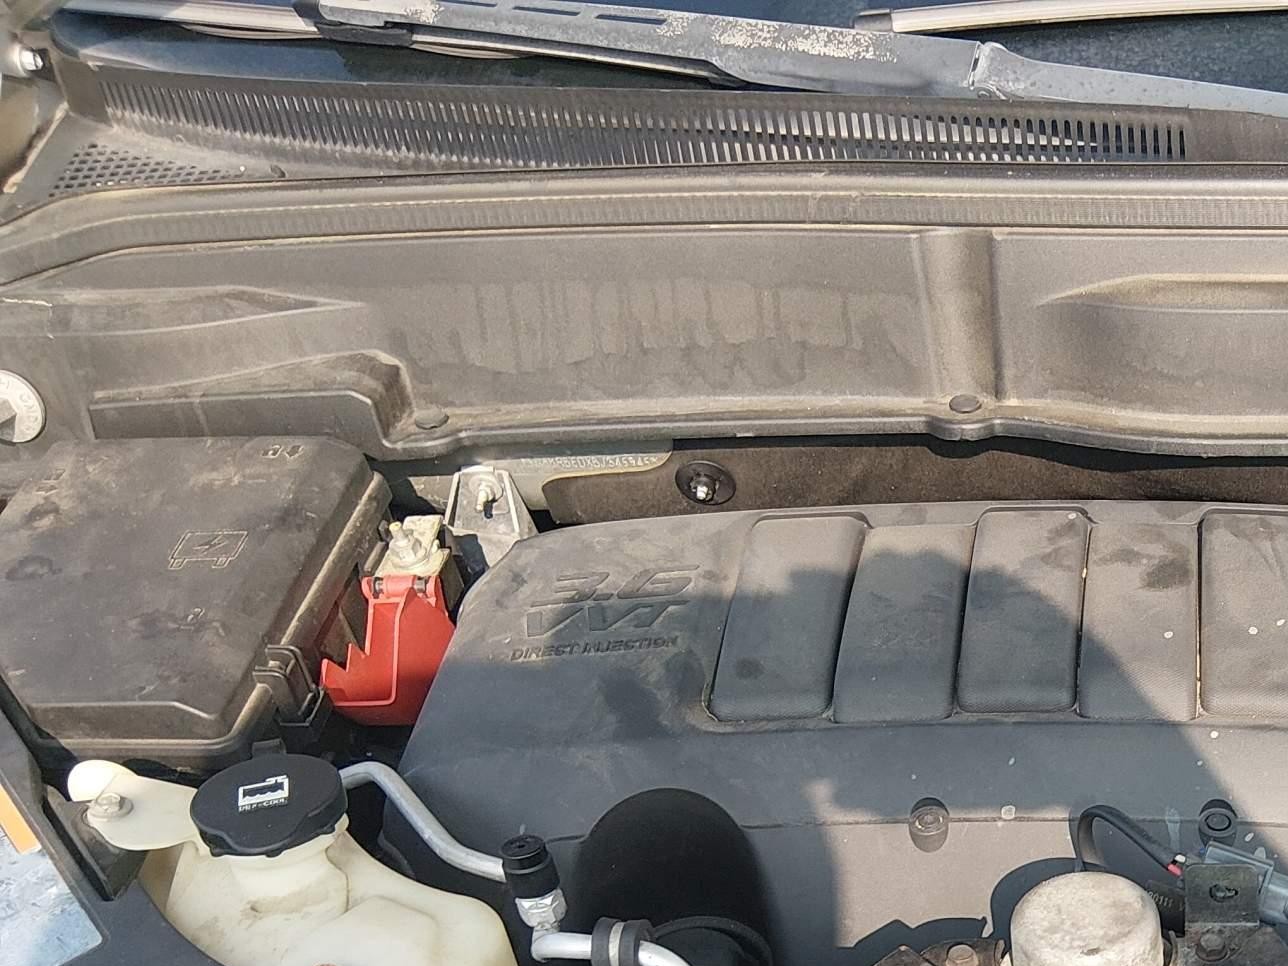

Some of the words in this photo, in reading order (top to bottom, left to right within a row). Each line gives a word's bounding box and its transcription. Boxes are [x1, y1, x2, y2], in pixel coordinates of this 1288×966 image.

[530, 564, 701, 608] 3.6
[526, 600, 691, 638] VVT
[510, 642, 578, 661] DIRECT
[580, 635, 680, 656] INJECTION
